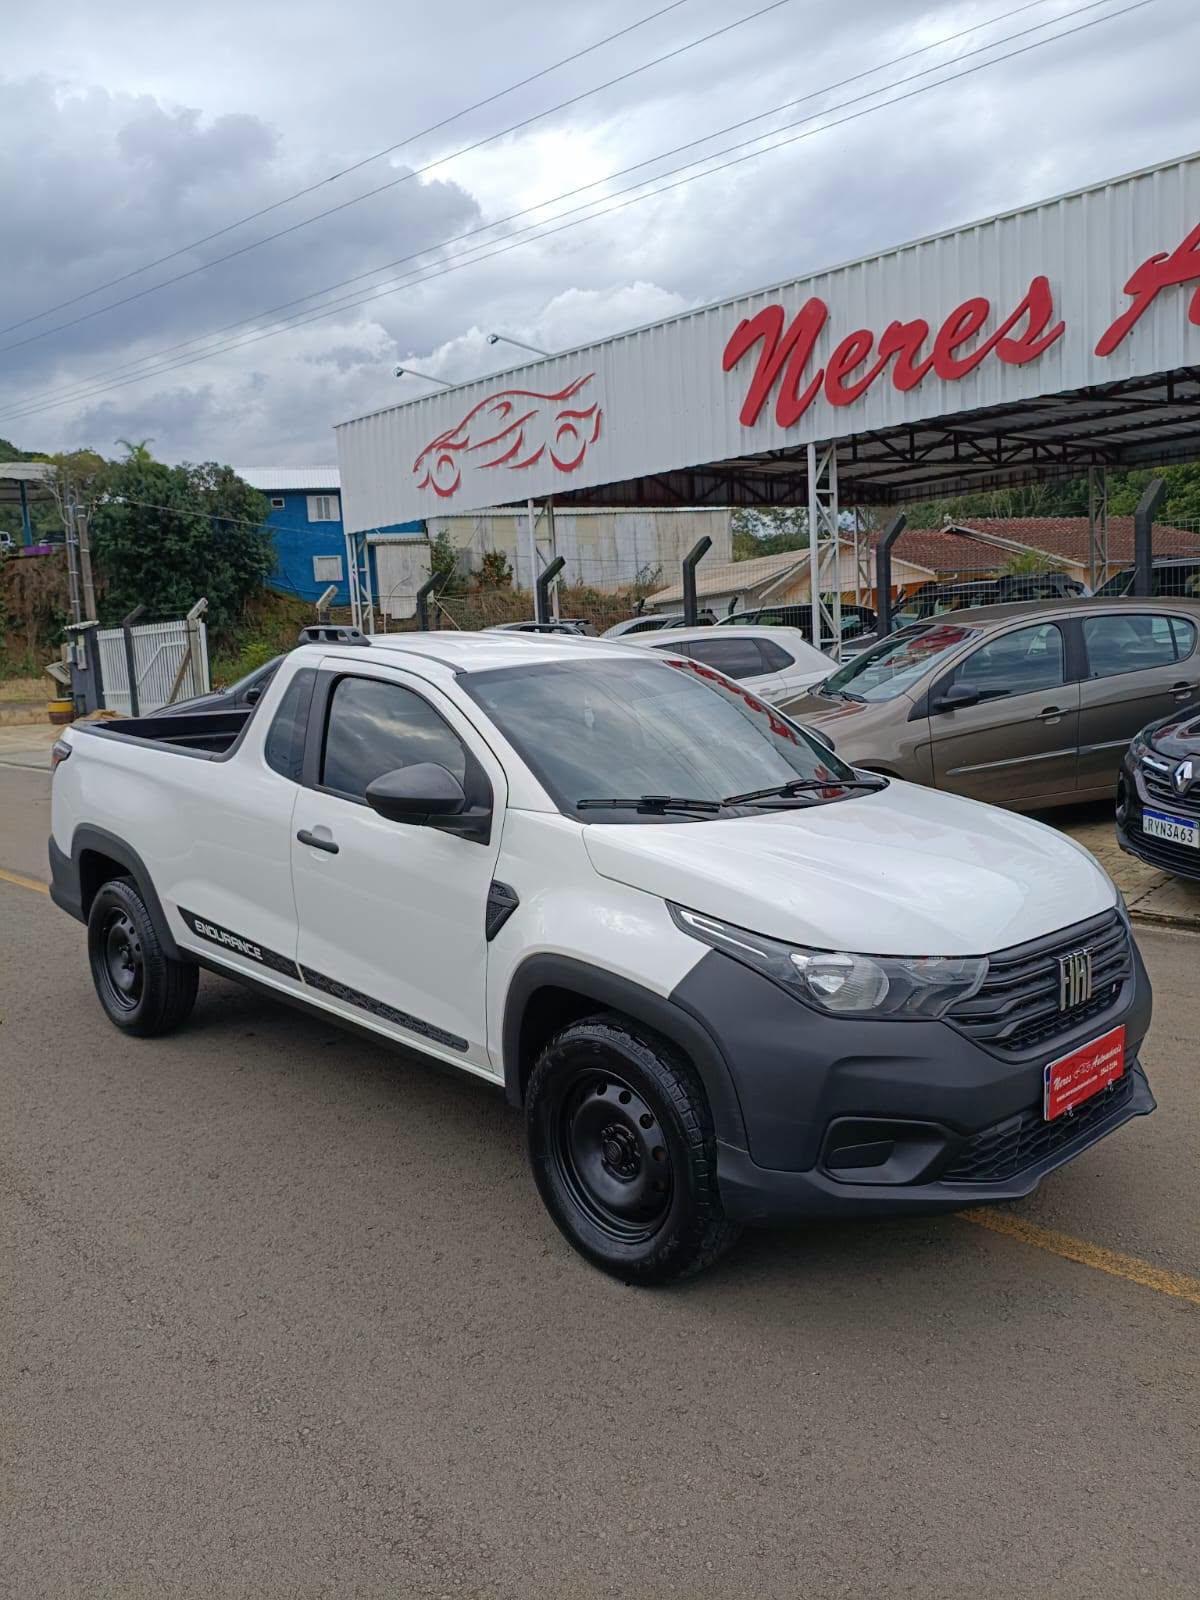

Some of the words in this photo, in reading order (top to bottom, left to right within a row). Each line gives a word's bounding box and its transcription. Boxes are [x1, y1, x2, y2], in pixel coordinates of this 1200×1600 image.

[722, 275, 1065, 428] Neres
[1147, 818, 1194, 843] RYN3A63
[194, 919, 264, 961] ENDURANCE
[1059, 946, 1094, 1012] FIAT
